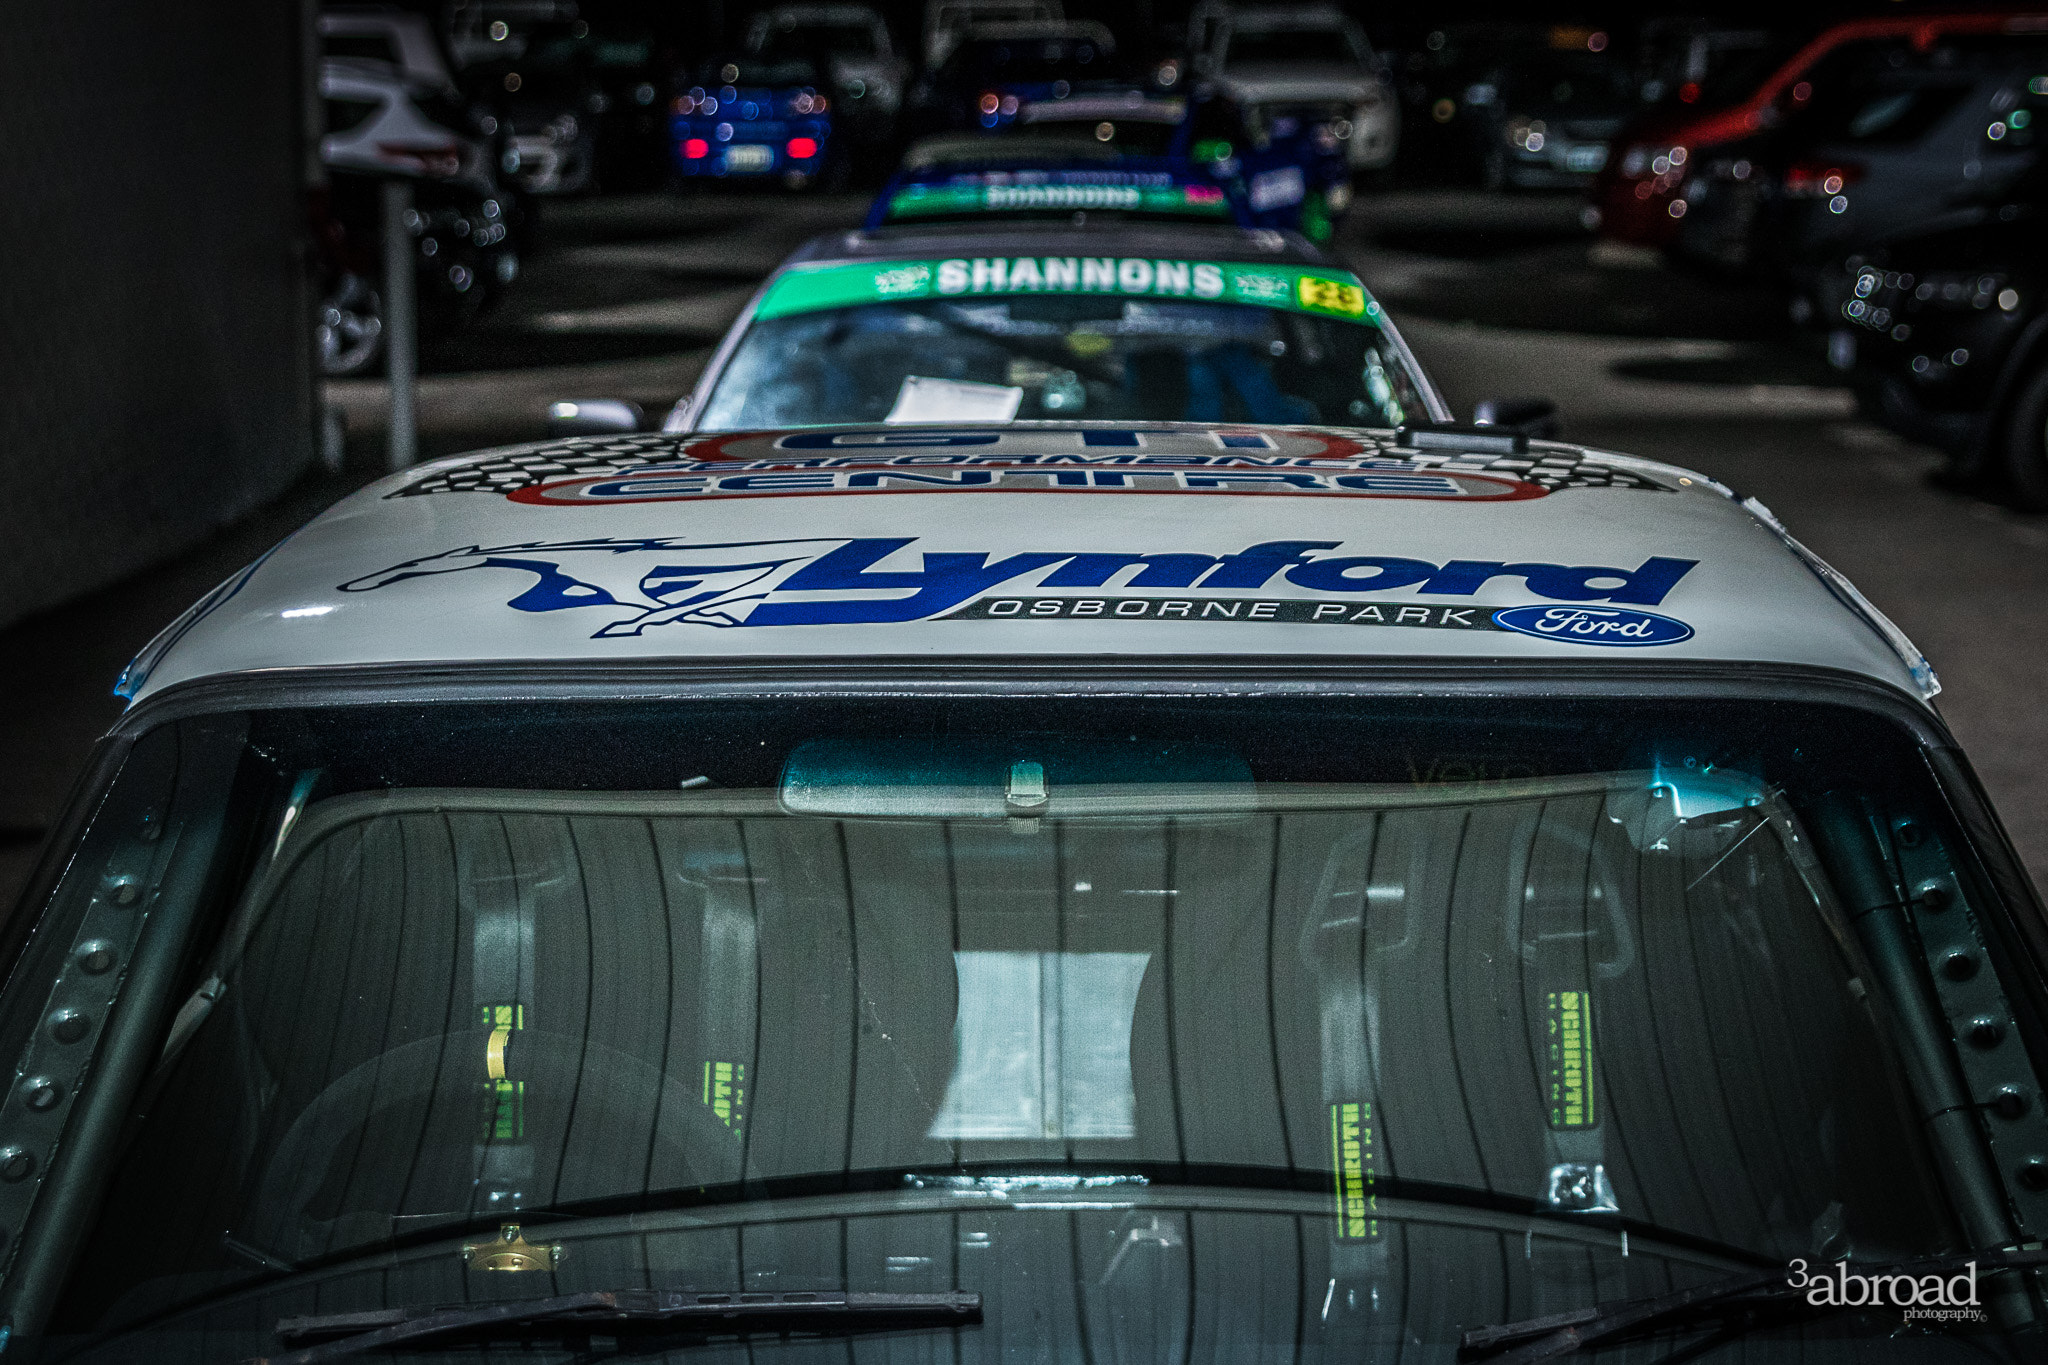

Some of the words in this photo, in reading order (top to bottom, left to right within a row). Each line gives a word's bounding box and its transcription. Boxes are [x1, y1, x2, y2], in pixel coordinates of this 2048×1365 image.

[937, 256, 1225, 299] SHANNONS
[613, 453, 1428, 476] PERFORMANCE
[579, 469, 1469, 497] CENTRE
[741, 537, 1700, 627] Lynford
[987, 599, 1282, 620] OSBORNE
[1312, 602, 1476, 627] PARK
[1534, 607, 1656, 639] Ford
